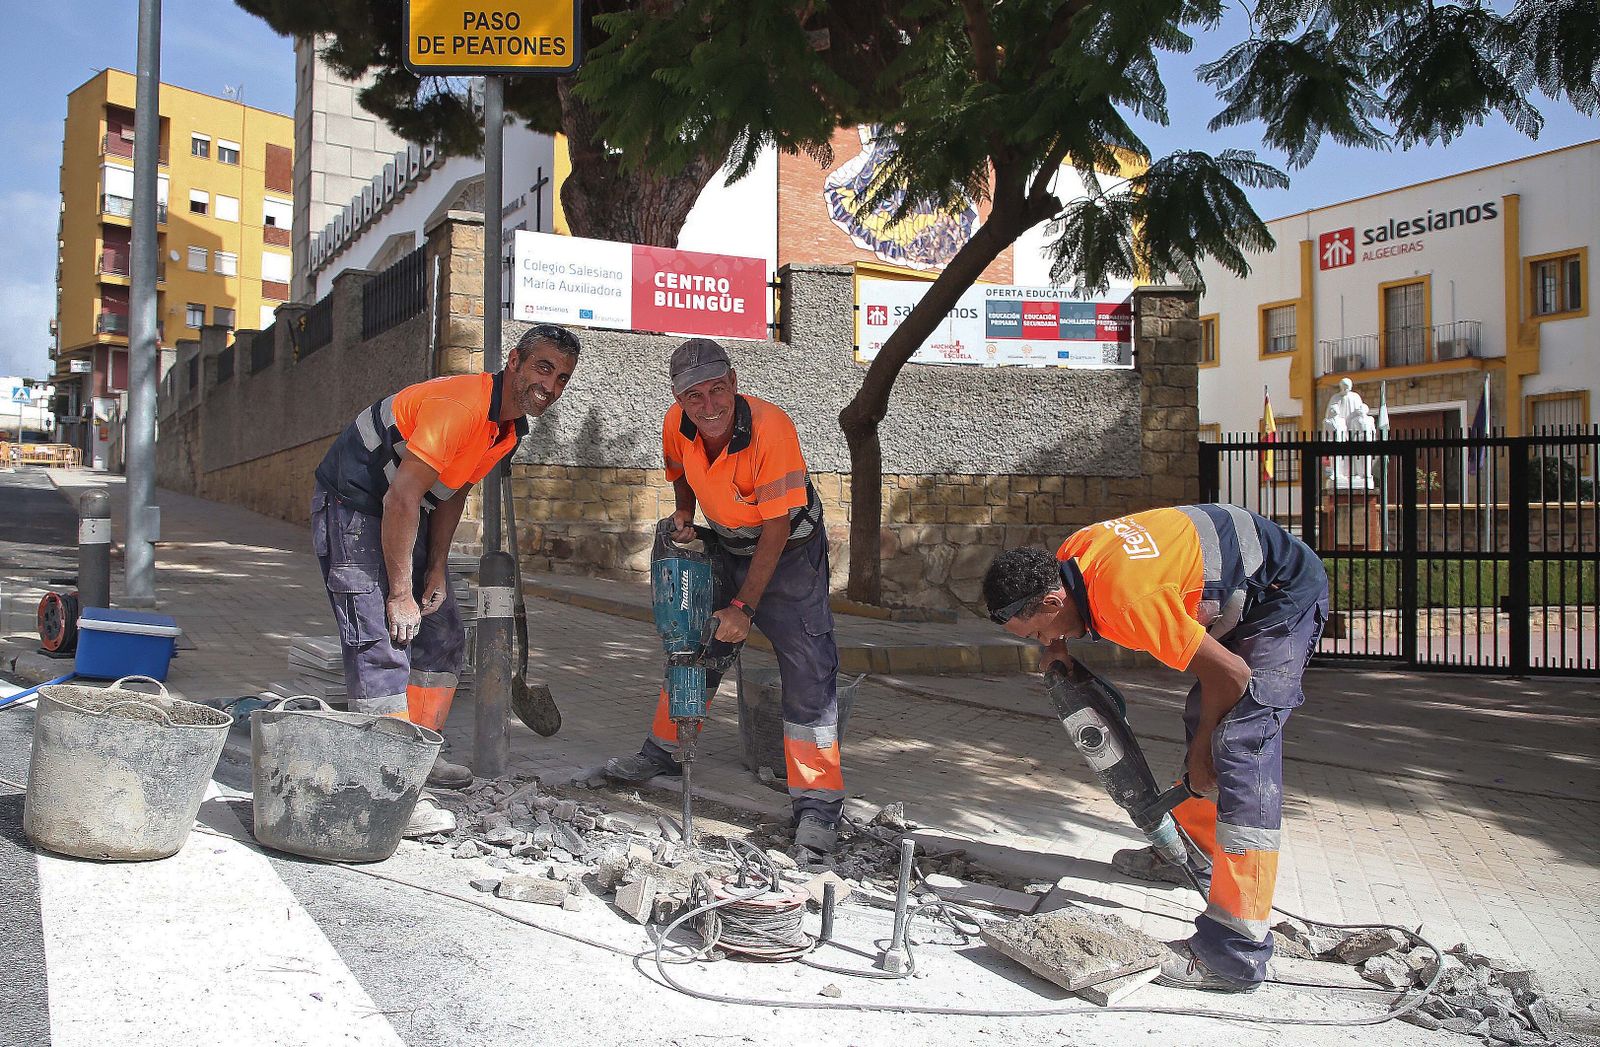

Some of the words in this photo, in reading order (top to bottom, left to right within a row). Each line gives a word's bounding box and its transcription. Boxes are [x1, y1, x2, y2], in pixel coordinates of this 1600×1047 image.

[463, 11, 521, 31] PASO
[417, 36, 445, 55] DE
[453, 36, 566, 56] PEATONES
[1362, 201, 1498, 246] salesianos
[1362, 240, 1424, 262] ALGECIRAS
[523, 258, 566, 276] Colegio
[568, 263, 623, 281] Salesiano
[523, 276, 556, 291] María
[558, 280, 622, 298] Auxiliadora
[654, 271, 730, 294] CENTRO
[985, 288, 1023, 298] OFERTA
[654, 290, 745, 314] BILINGÜE
[893, 302, 978, 319] salnos
